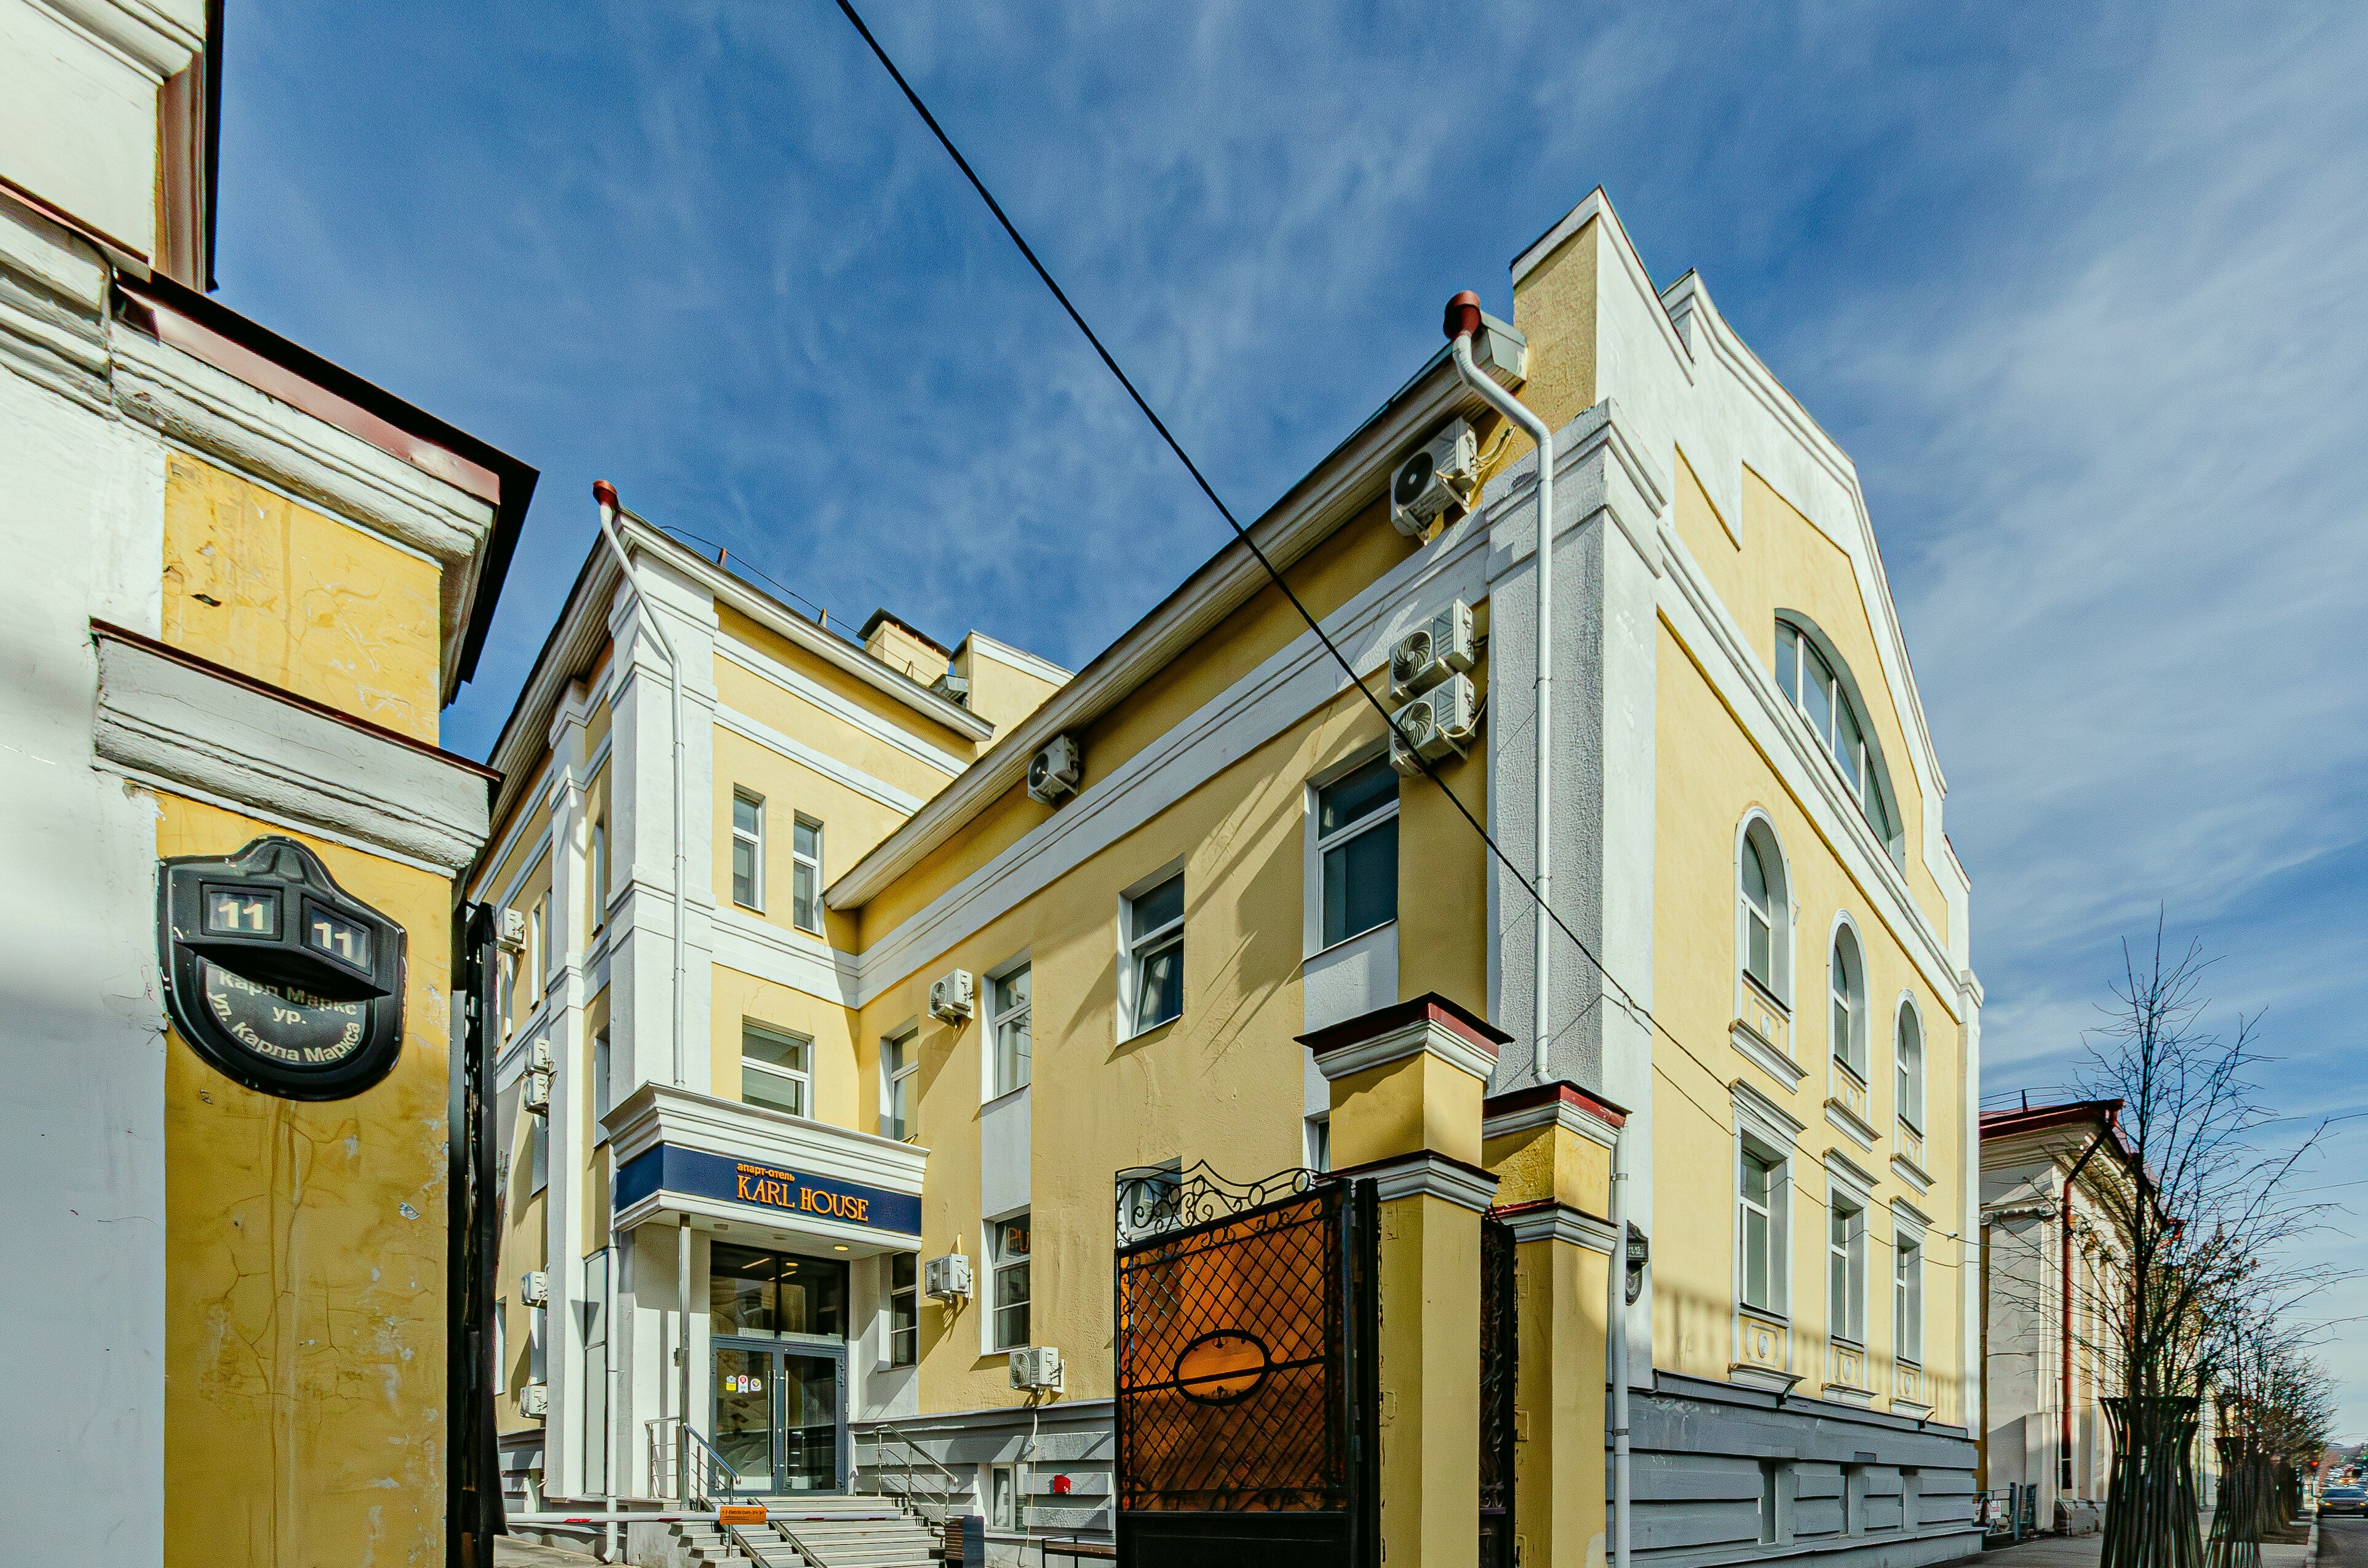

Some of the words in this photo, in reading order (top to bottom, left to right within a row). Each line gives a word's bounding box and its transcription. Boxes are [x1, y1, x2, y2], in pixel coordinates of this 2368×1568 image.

[218, 901, 264, 930] 11
[313, 922, 352, 959] 11
[218, 970, 279, 996] Карл
[206, 991, 232, 1022] ул.
[231, 1021, 300, 1062] Карла
[303, 1021, 361, 1063] Маркса
[272, 1006, 308, 1025] ур.
[736, 1162, 795, 1182] апарт-отель
[737, 1174, 795, 1208] KARL
[800, 1187, 869, 1222] HOUSE
